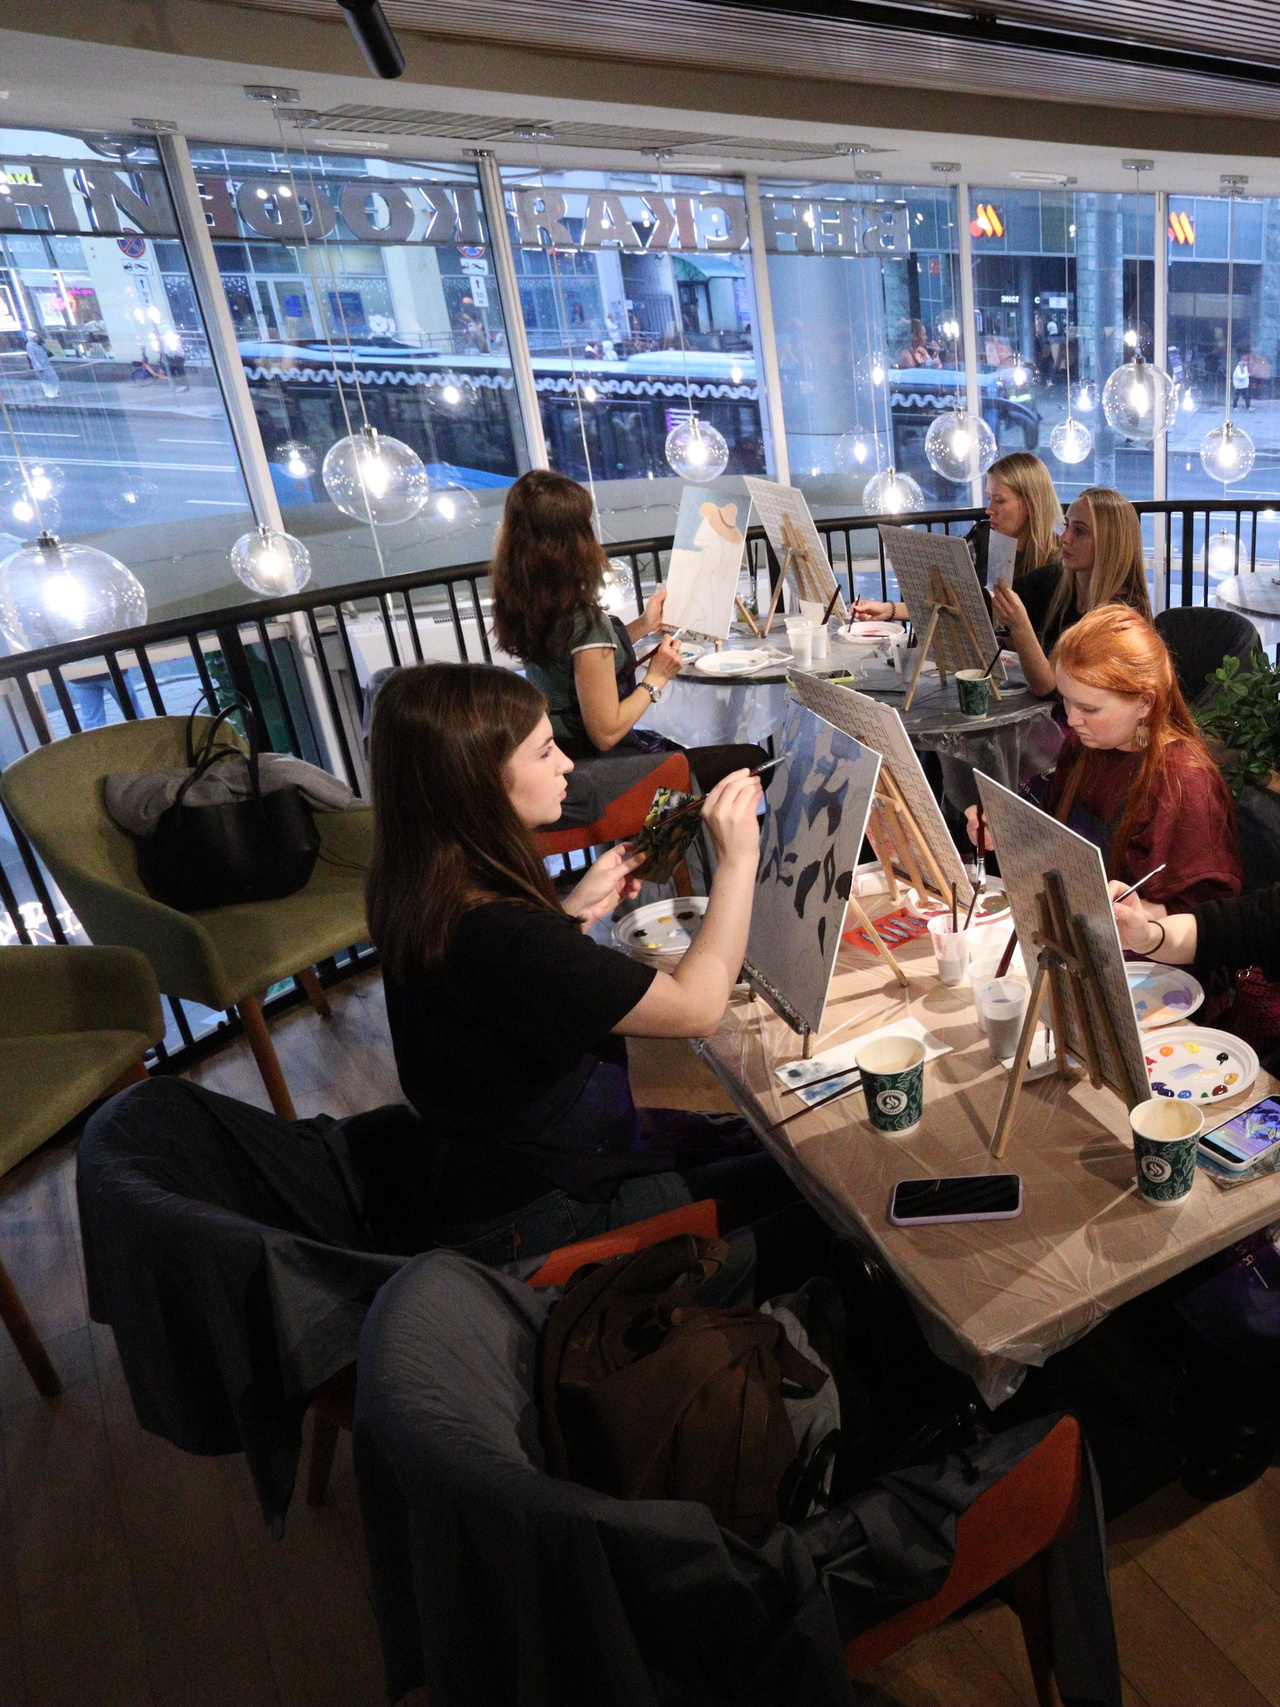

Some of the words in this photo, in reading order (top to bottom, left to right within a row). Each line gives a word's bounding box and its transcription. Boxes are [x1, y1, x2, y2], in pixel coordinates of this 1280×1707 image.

[7, 173, 36, 185] AKE
[56, 242, 81, 254] COF
[476, 291, 484, 299] 10
